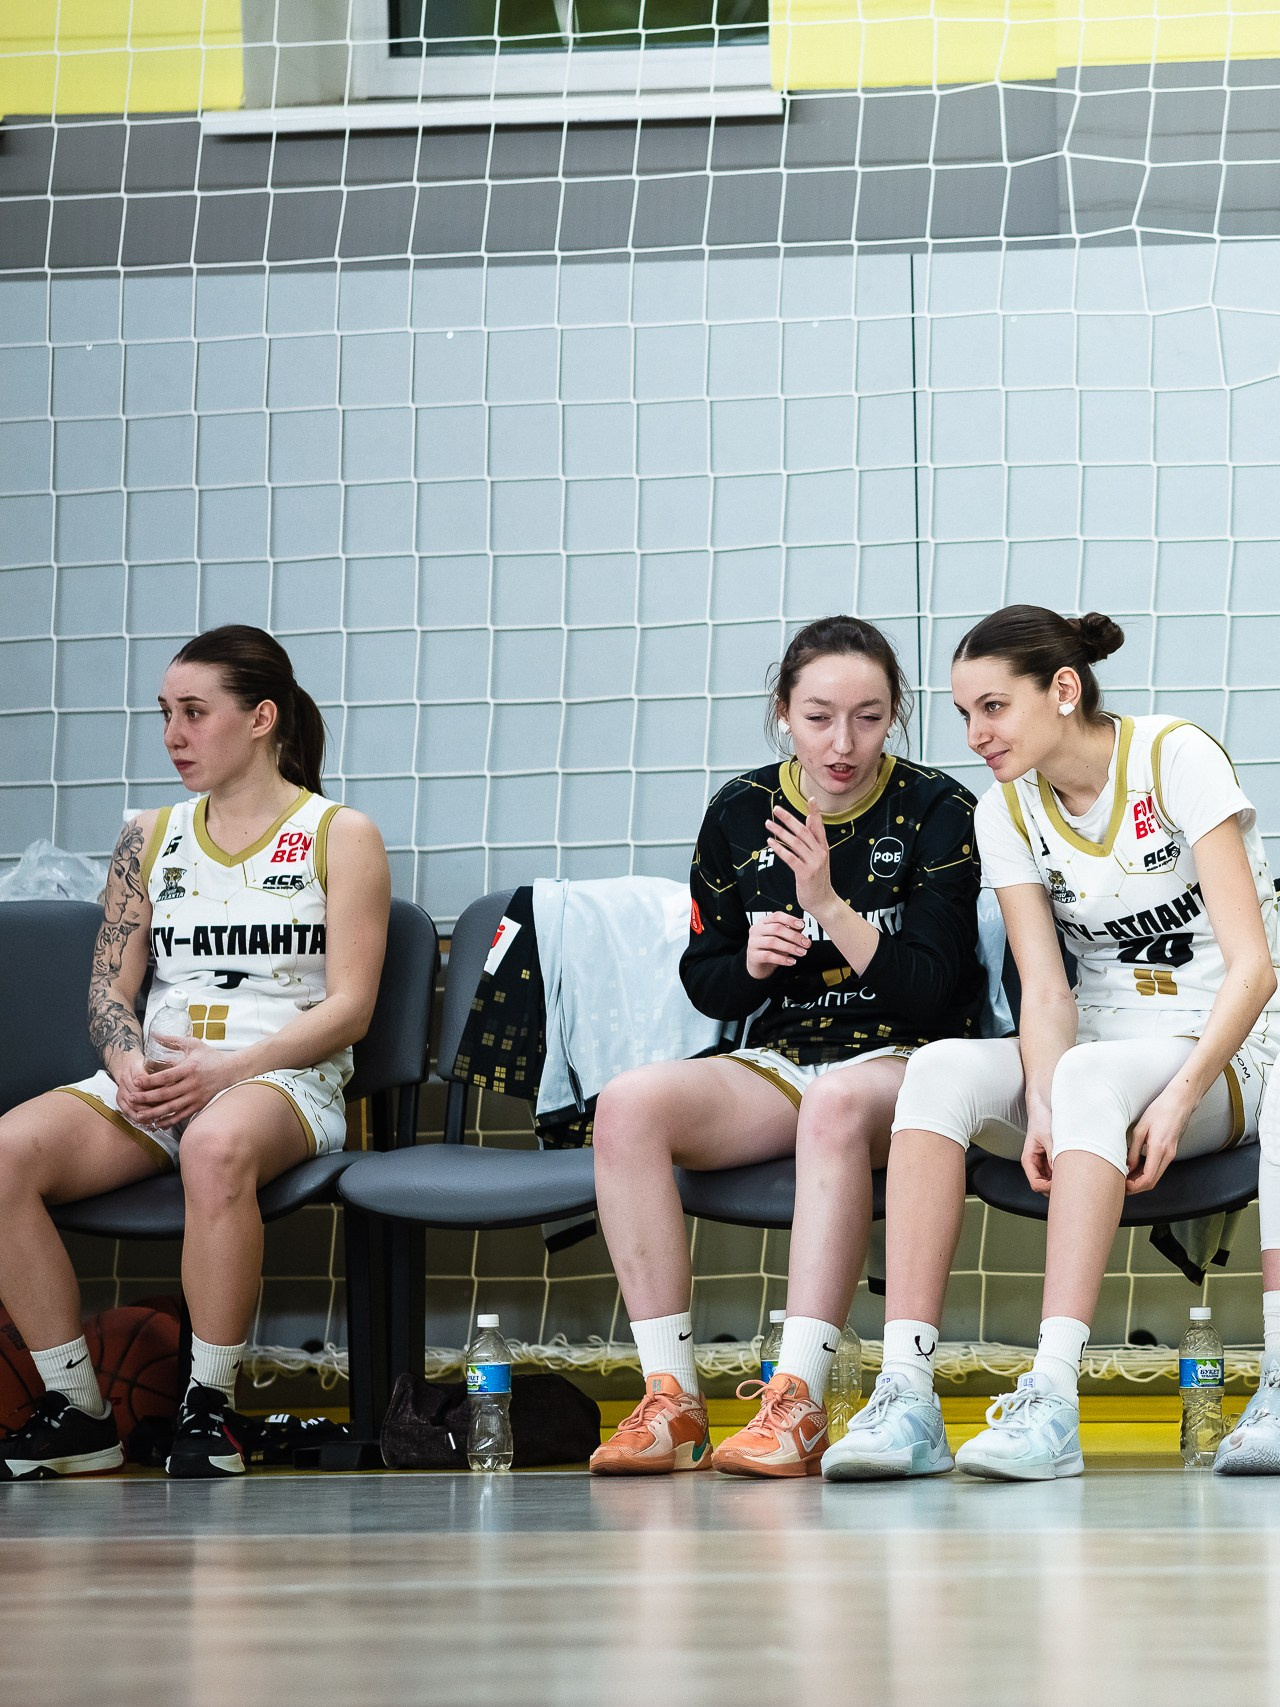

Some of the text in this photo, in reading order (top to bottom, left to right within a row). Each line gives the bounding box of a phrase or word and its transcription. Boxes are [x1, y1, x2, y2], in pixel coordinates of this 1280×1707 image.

[277, 832, 313, 852] FON
[873, 852, 902, 863] РФБ
[151, 924, 327, 957] ГУ-АТЛАНТА
